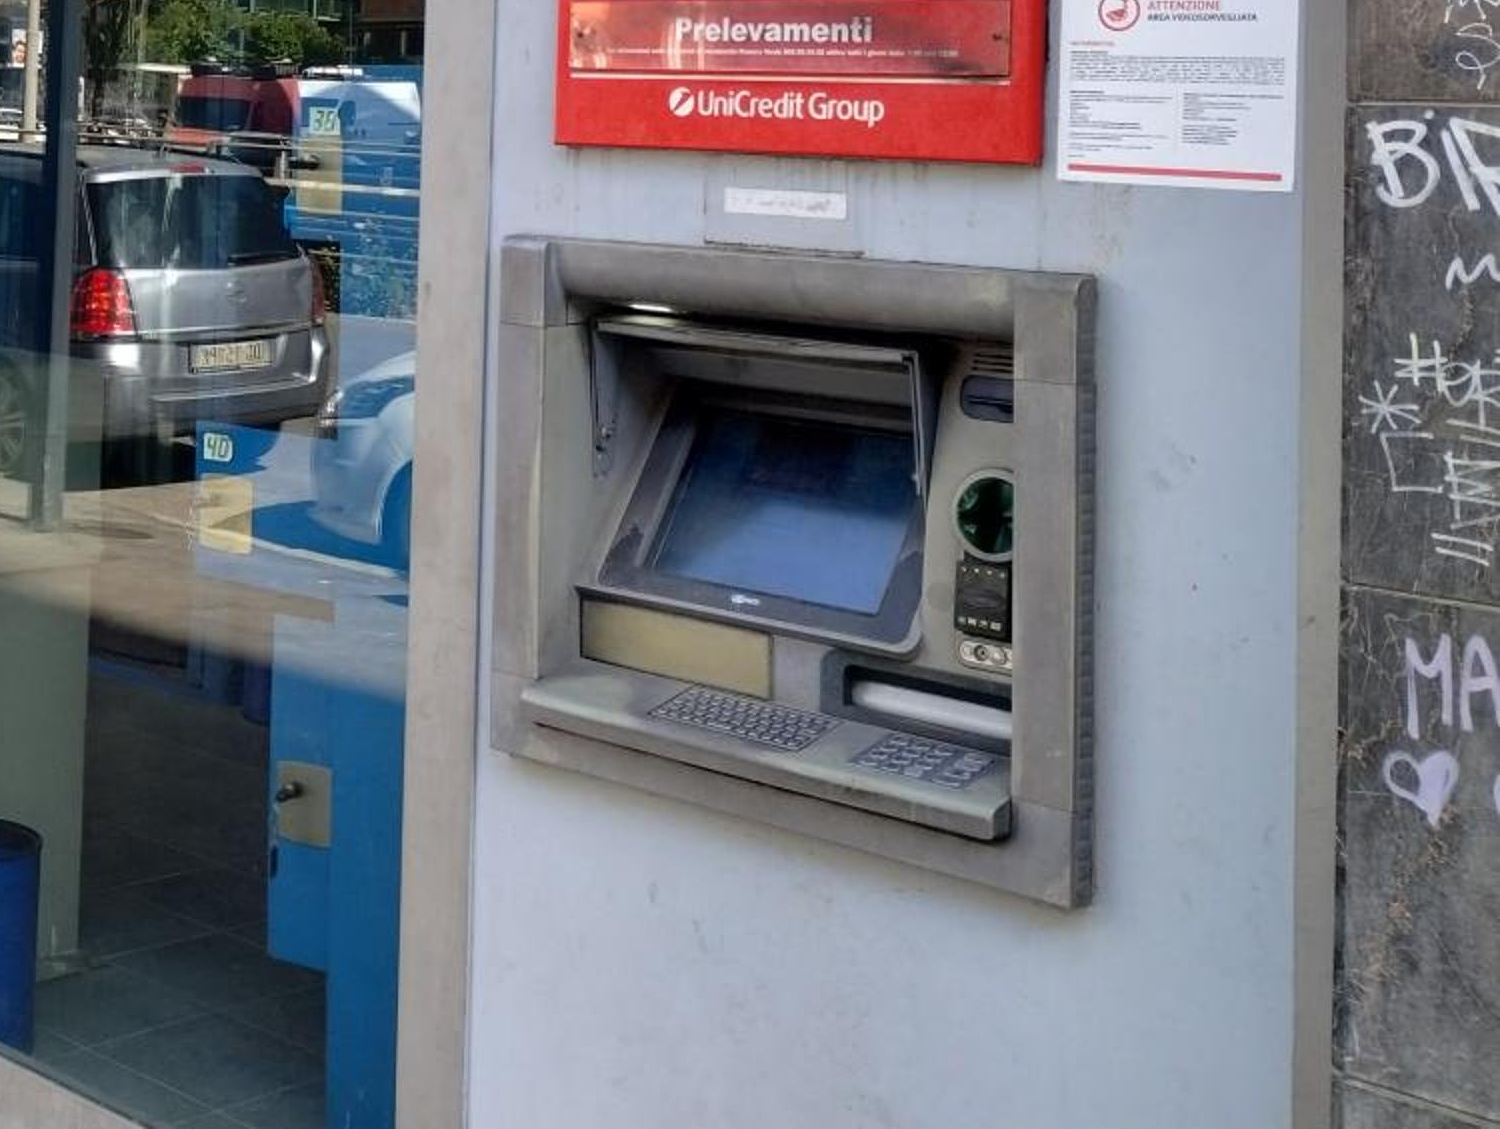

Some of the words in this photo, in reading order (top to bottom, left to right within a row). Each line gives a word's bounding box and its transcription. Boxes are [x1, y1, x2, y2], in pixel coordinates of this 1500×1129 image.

[1147, 0, 1221, 11] ATTENZIONE
[1147, 13, 1171, 22] AREA
[675, 16, 873, 44] Prelevamenti
[698, 88, 804, 120] UniCredit
[809, 91, 886, 128] Group
